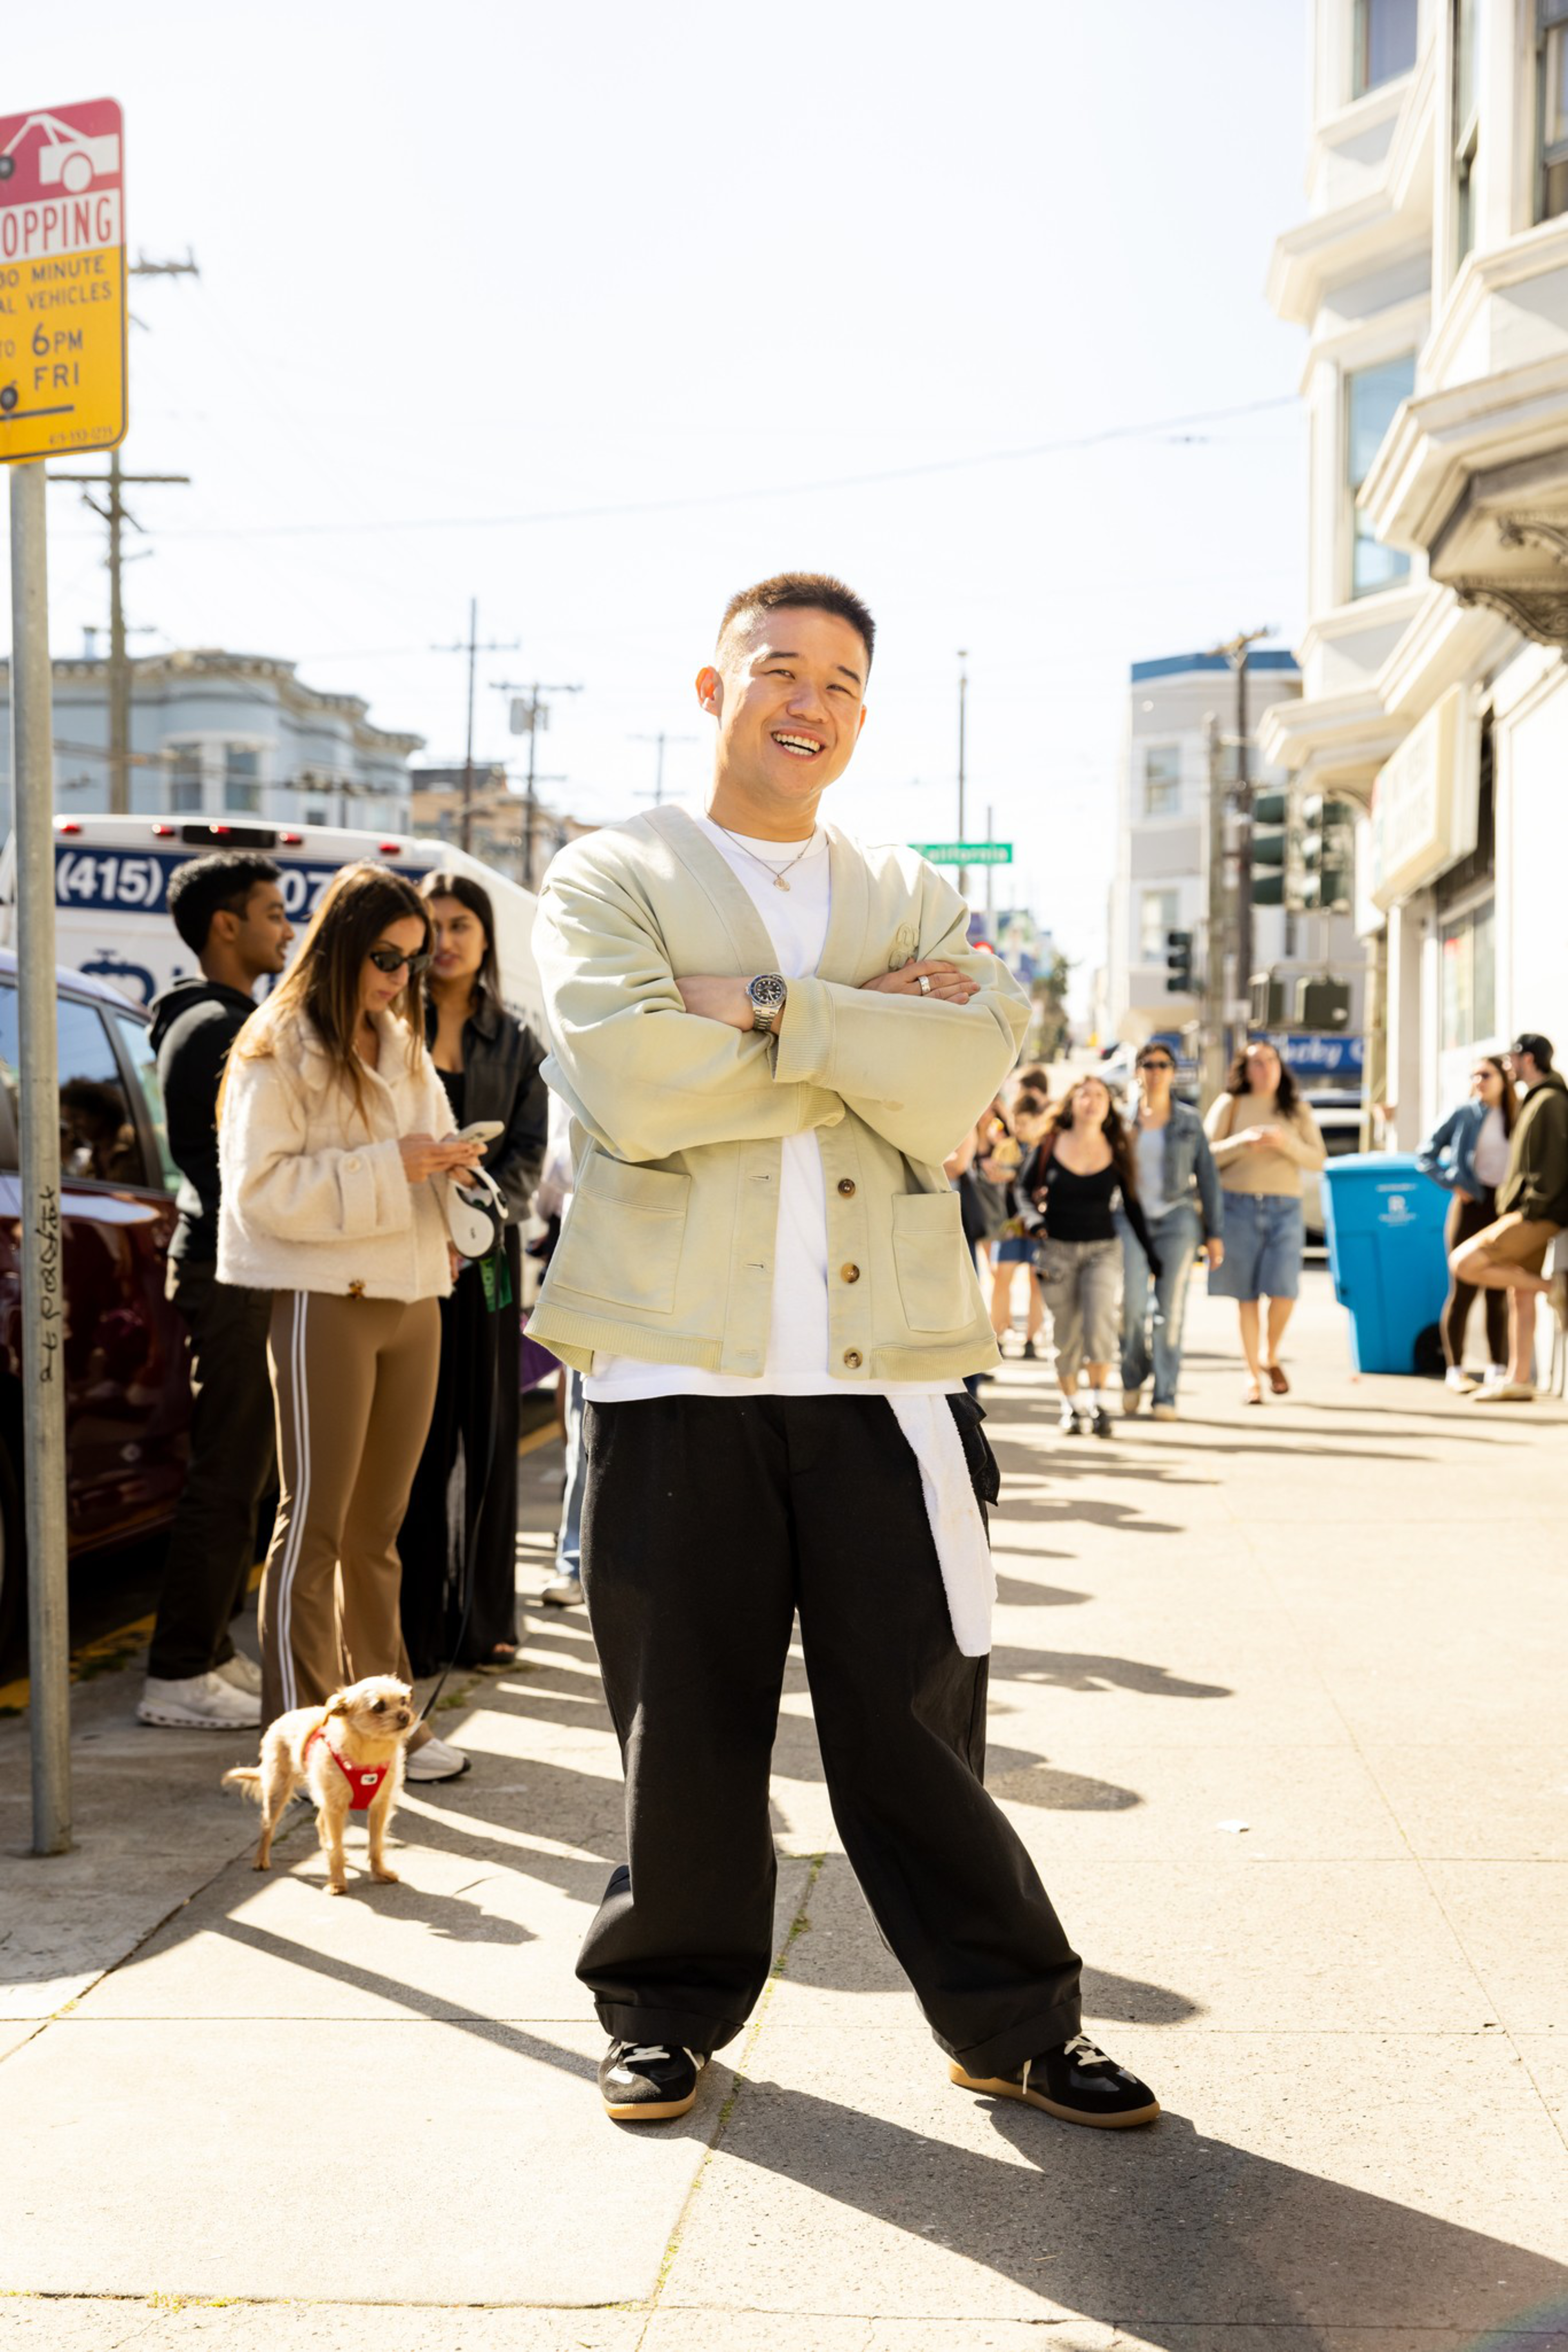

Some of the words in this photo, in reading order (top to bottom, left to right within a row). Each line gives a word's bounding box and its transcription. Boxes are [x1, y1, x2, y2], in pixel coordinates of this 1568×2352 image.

[2, 196, 111, 257] OPPING
[31, 254, 105, 283] MINUTE
[26, 280, 112, 312] VEHICLES
[34, 362, 79, 391] FRI
[57, 852, 163, 907] (415)
